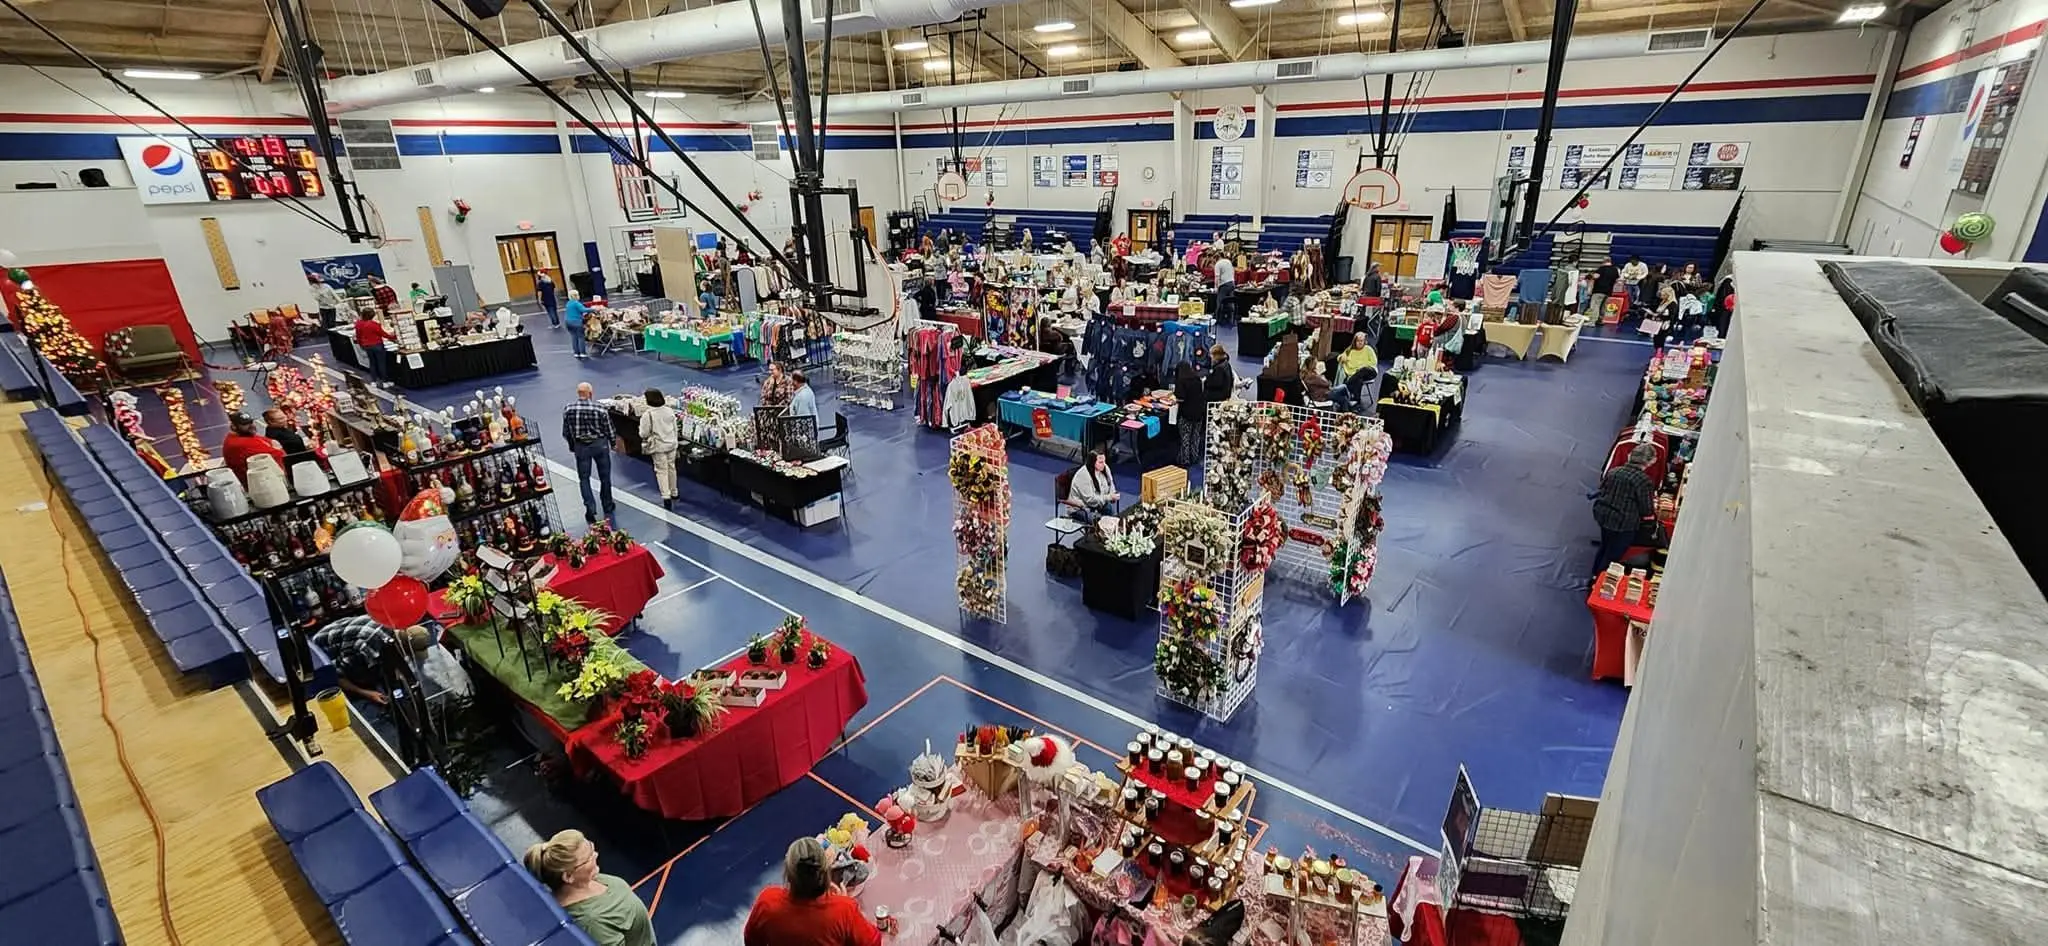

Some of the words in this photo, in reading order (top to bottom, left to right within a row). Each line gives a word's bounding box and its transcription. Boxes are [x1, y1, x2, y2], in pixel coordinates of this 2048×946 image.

[210, 151, 229, 170] 0
[300, 150, 316, 169] 0
[148, 182, 196, 196] pepsi
